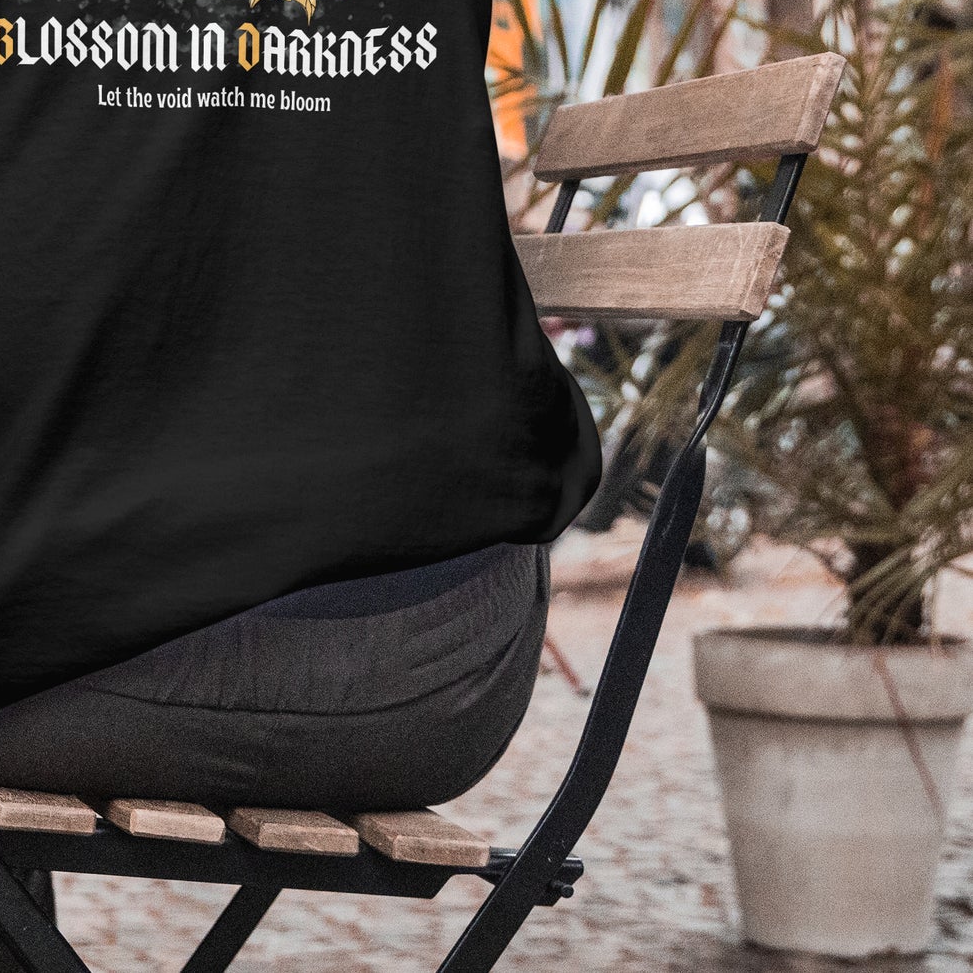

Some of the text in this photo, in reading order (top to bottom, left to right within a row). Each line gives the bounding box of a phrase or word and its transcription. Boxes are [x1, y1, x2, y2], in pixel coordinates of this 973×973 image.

[187, 22, 229, 73] IN
[237, 22, 438, 79] DARKNESS
[97, 84, 332, 113] Let the void watch me bloom
